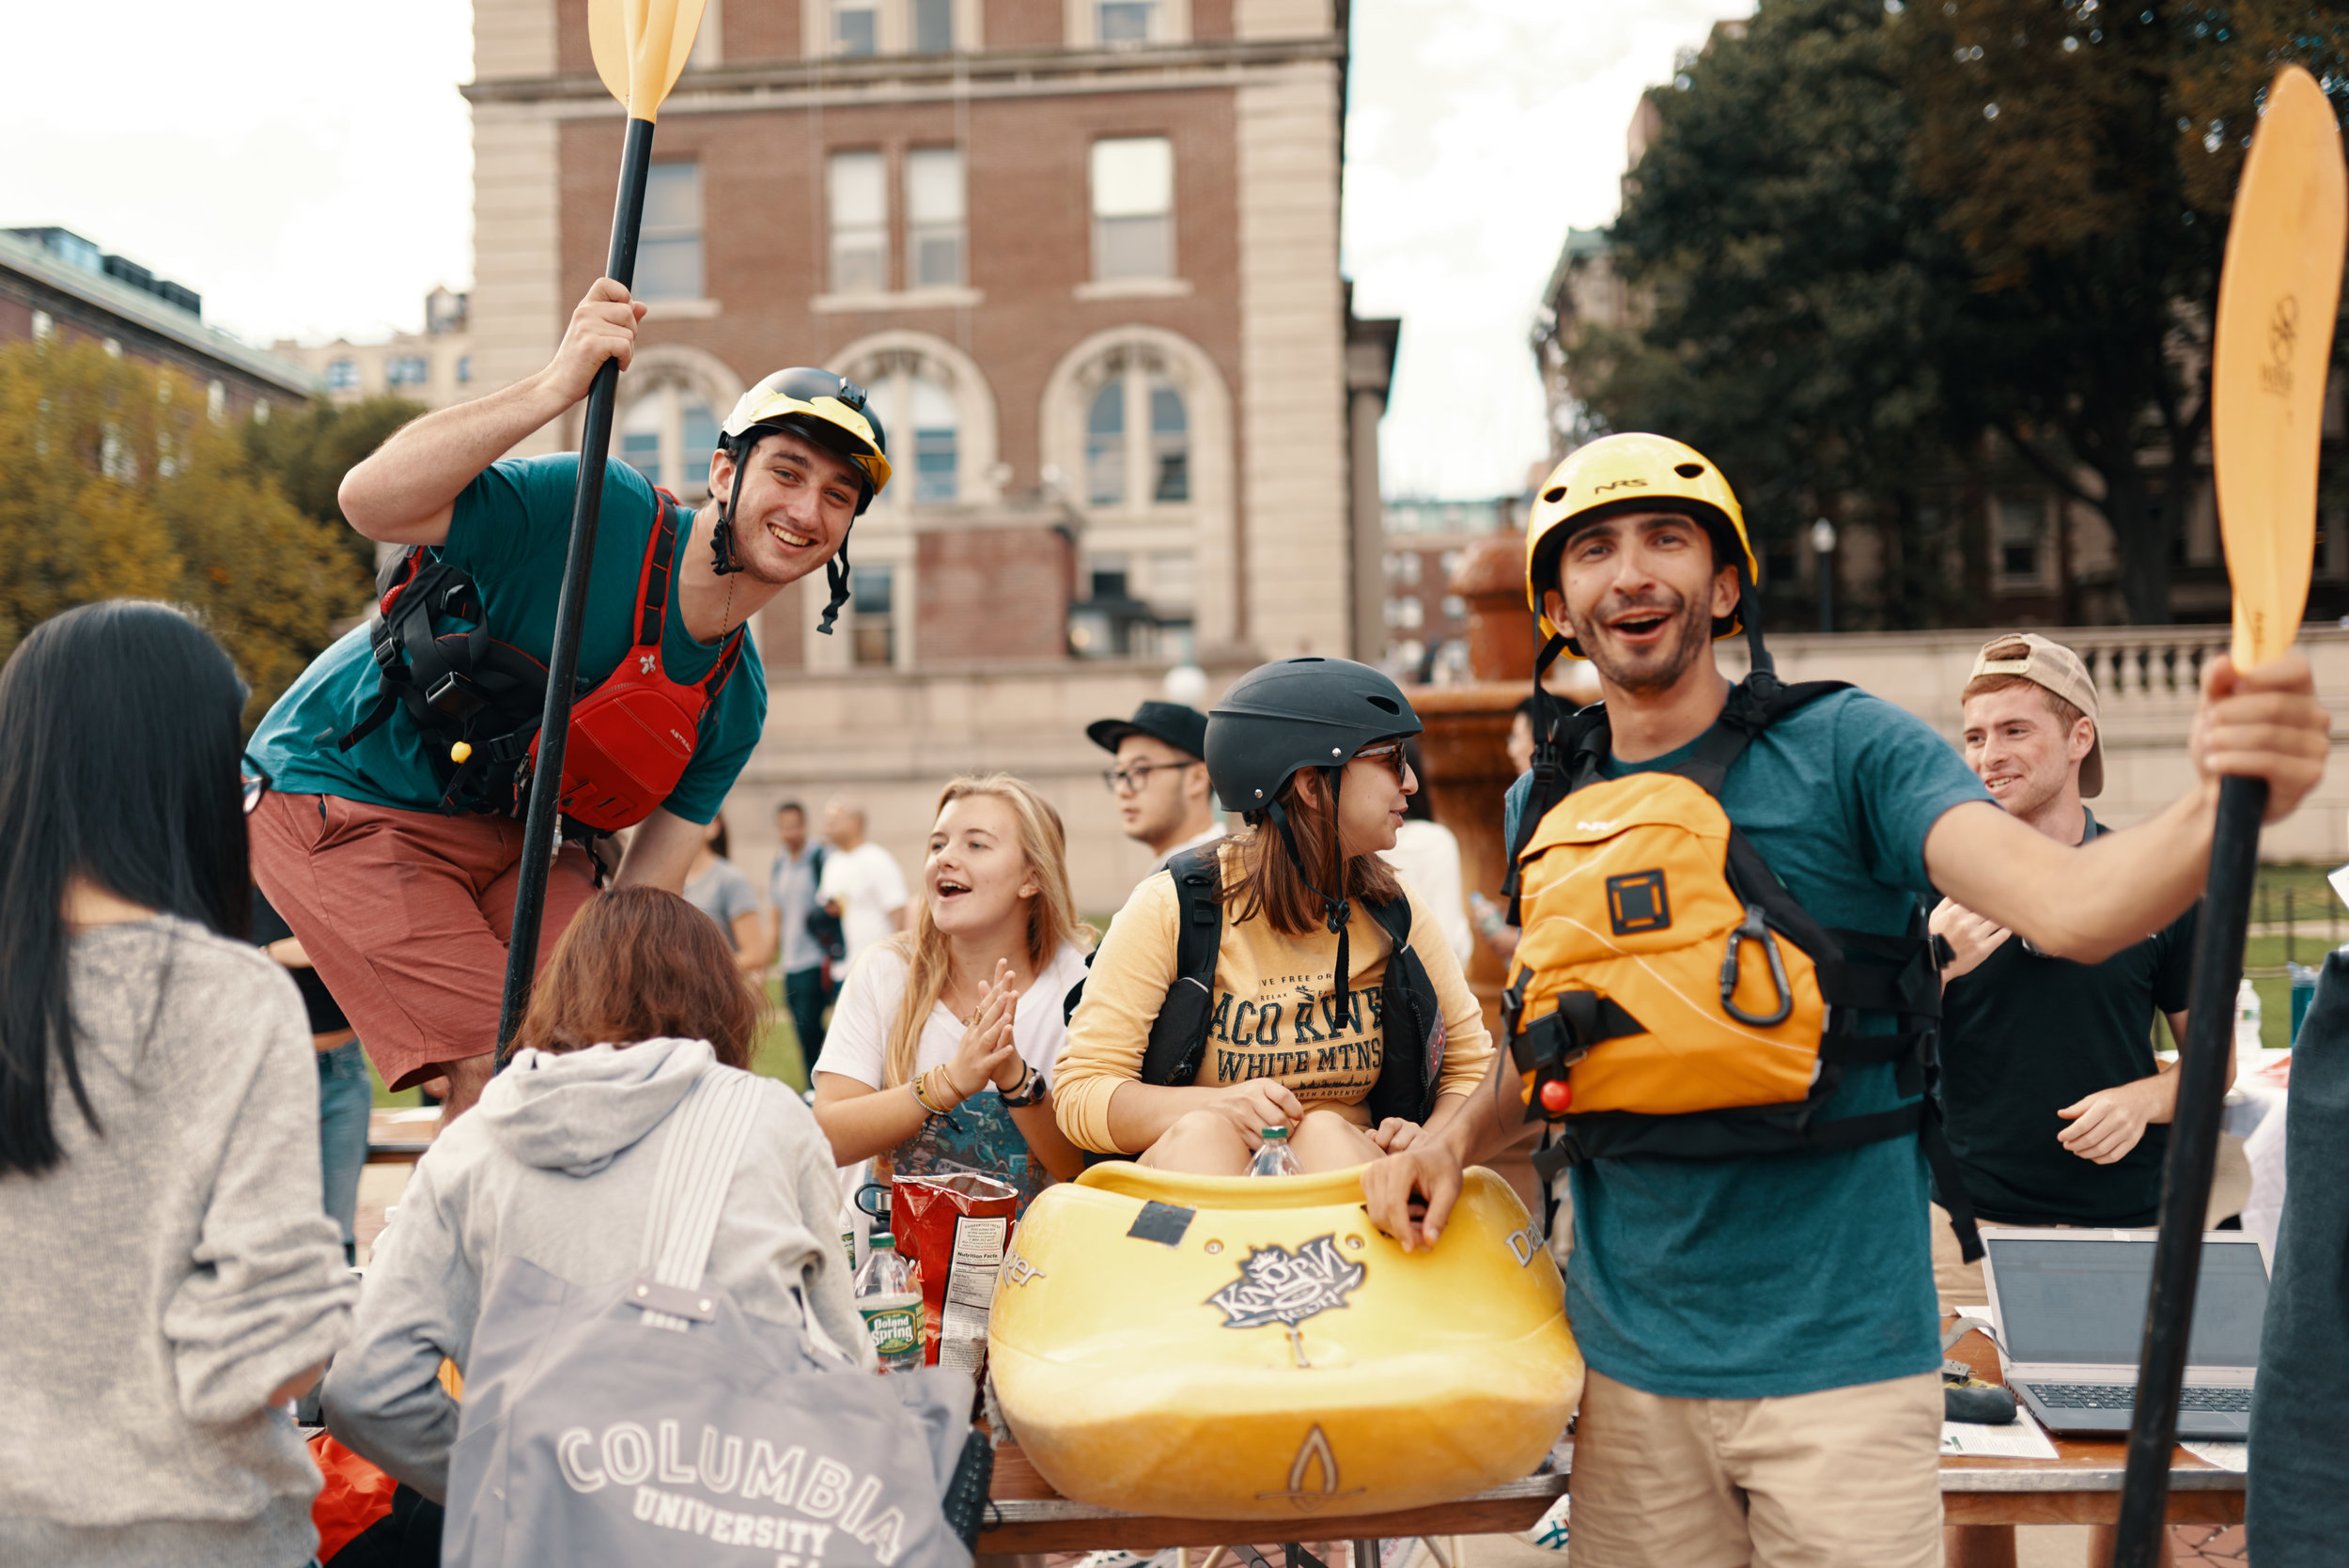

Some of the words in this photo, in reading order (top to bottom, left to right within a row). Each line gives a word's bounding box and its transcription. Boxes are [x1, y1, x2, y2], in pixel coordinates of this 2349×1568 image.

[1594, 478, 1648, 495] NRS
[1281, 974, 1311, 984] FREE
[1317, 972, 1332, 981] OR
[1260, 992, 1287, 1001] RELAX
[1209, 992, 1283, 1047] ACO
[1294, 986, 1383, 1045] RIVE
[1217, 1048, 1311, 1083] WHITE
[1316, 1037, 1382, 1072] MTNS
[874, 1315, 910, 1330] Poland
[870, 1325, 914, 1347] Spring
[557, 1419, 906, 1566] COLUMBIA
[632, 1485, 833, 1557] UNIVERSITY
